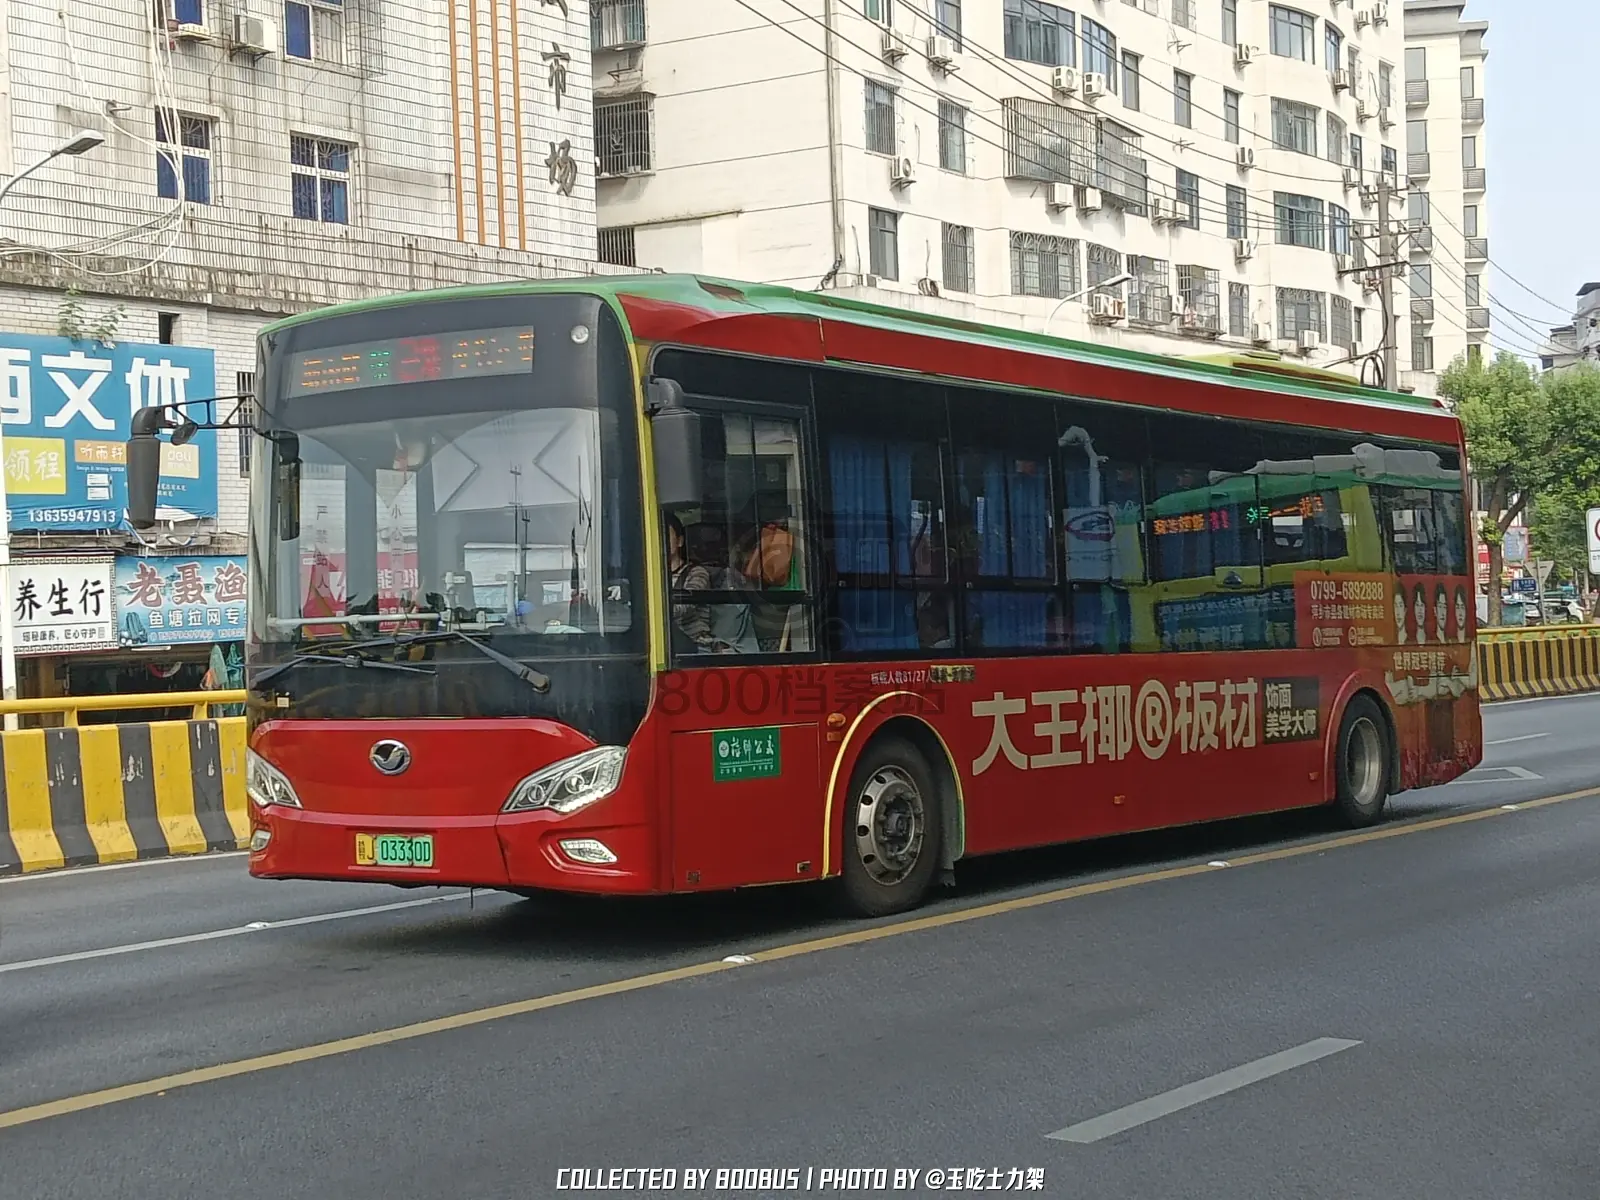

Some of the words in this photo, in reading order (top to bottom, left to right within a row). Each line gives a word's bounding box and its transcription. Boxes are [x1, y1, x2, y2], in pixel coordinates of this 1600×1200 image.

[28, 509, 116, 522] 13635947913
[14, 577, 105, 621] 养生行
[1310, 580, 1384, 601] 0799-6892888
[148, 607, 247, 629] 鱼塘拉网专
[1392, 651, 1446, 672] 世界冠军推荐
[1265, 683, 1292, 709] 饰面
[1265, 709, 1317, 738] 美学大师
